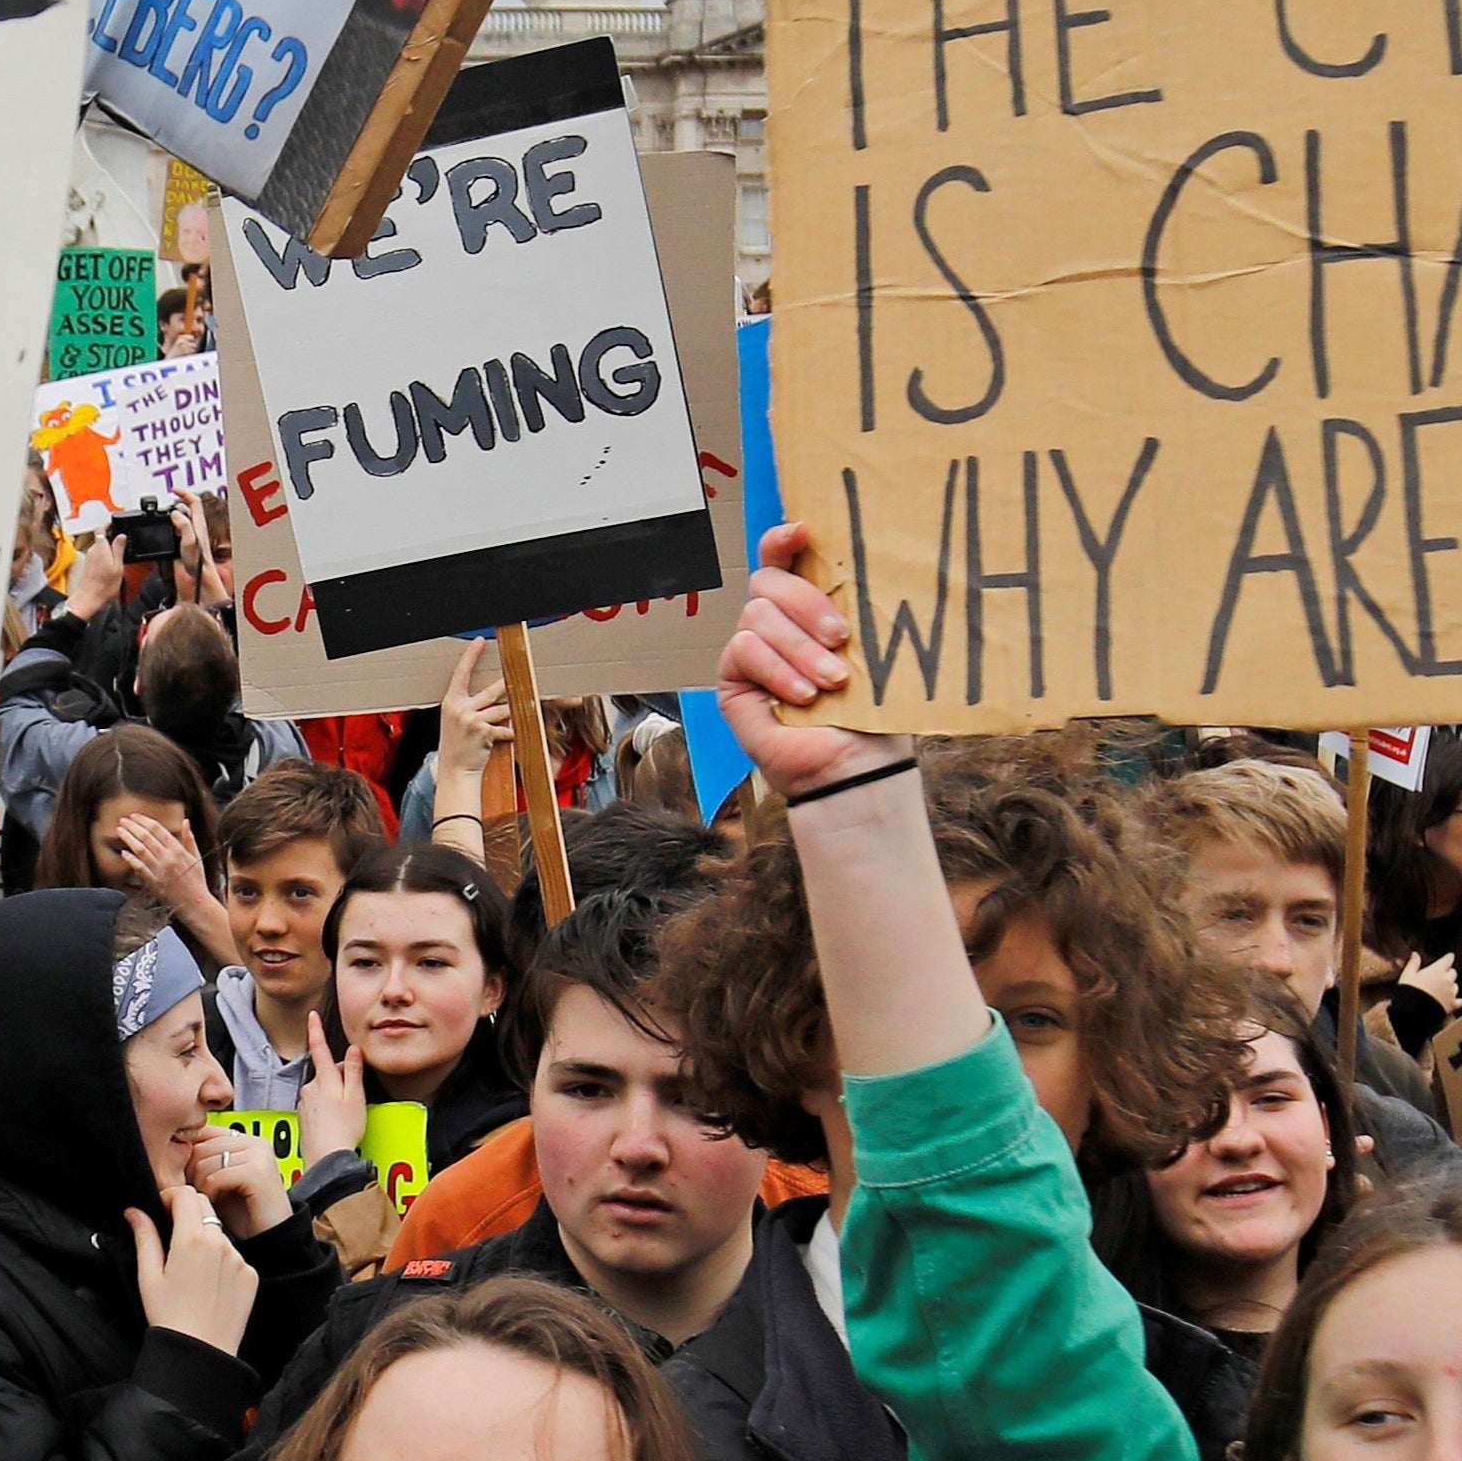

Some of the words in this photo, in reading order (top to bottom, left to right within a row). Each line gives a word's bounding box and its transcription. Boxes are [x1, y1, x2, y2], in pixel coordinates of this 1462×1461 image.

[242, 134, 603, 291] WE'RE
[57, 253, 104, 283] GET
[108, 255, 154, 283] OFF
[71, 285, 139, 313] YOUR
[854, 164, 1004, 432] IS
[57, 313, 145, 337] ASSES
[59, 344, 82, 368] &
[86, 343, 146, 369] STOP
[126, 385, 169, 414] THE
[174, 379, 220, 411] DIN
[278, 326, 662, 500] FUMING
[131, 404, 224, 442] THOUGH
[136, 435, 202, 467] THEY
[152, 451, 223, 493] TIM
[840, 436, 1159, 706] WHY
